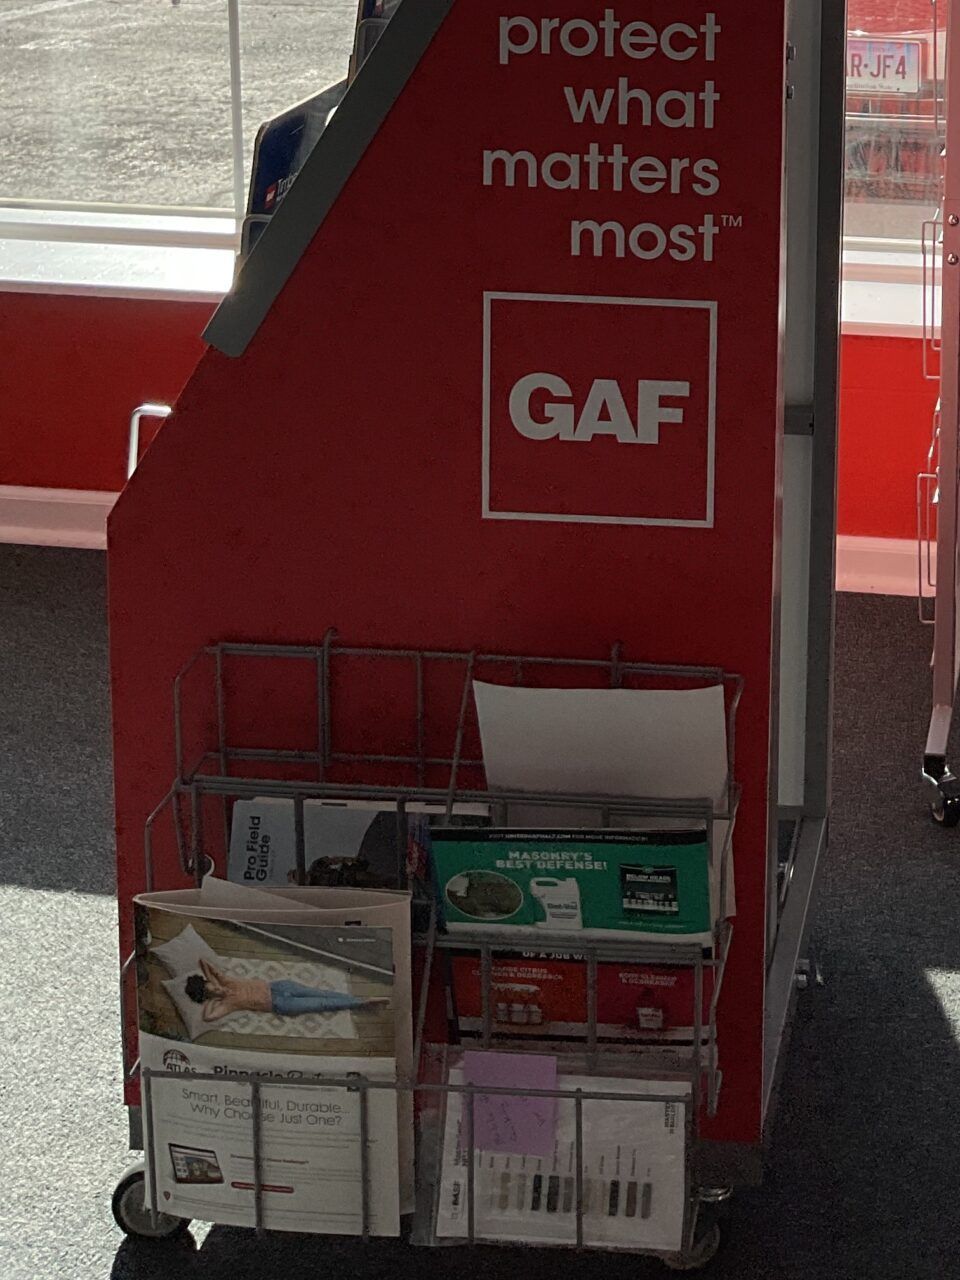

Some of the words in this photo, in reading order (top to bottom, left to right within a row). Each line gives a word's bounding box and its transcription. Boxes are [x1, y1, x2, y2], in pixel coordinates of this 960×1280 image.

[499, 8, 721, 64] protect
[563, 77, 720, 129] what
[482, 143, 720, 196] matters
[508, 372, 690, 444] GAF
[246, 815, 261, 852] Field
[244, 852, 258, 881] Pro
[256, 834, 271, 882] Guide
[496, 859, 533, 869] BEST
[536, 860, 608, 871] DEFENSE!
[508, 851, 593, 861] MASONRY'S
[190, 1101, 221, 1120] Why
[279, 1113, 304, 1125] Just
[306, 1114, 342, 1126] One?
